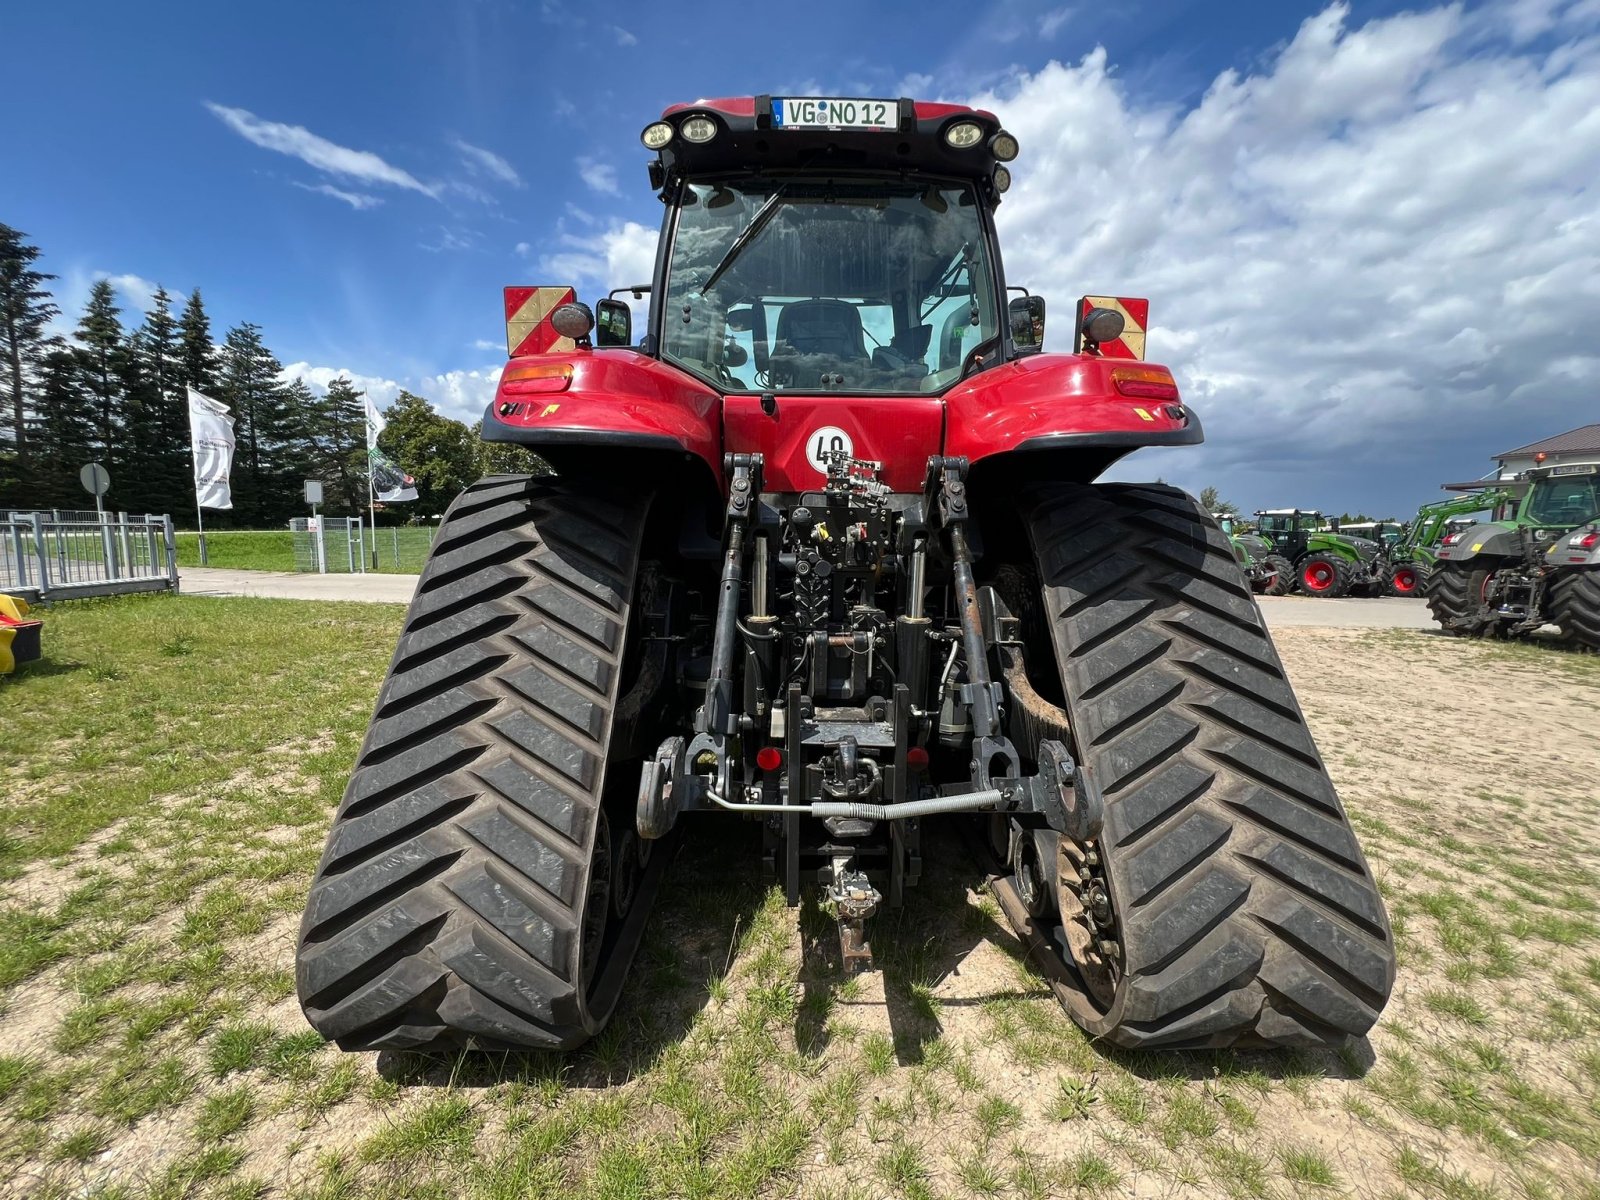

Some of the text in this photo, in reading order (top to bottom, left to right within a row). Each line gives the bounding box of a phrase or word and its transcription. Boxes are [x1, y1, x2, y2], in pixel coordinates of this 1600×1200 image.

[789, 102, 816, 123] VG
[829, 102, 857, 124] NO
[861, 104, 886, 125] 12
[816, 435, 844, 466] 40
